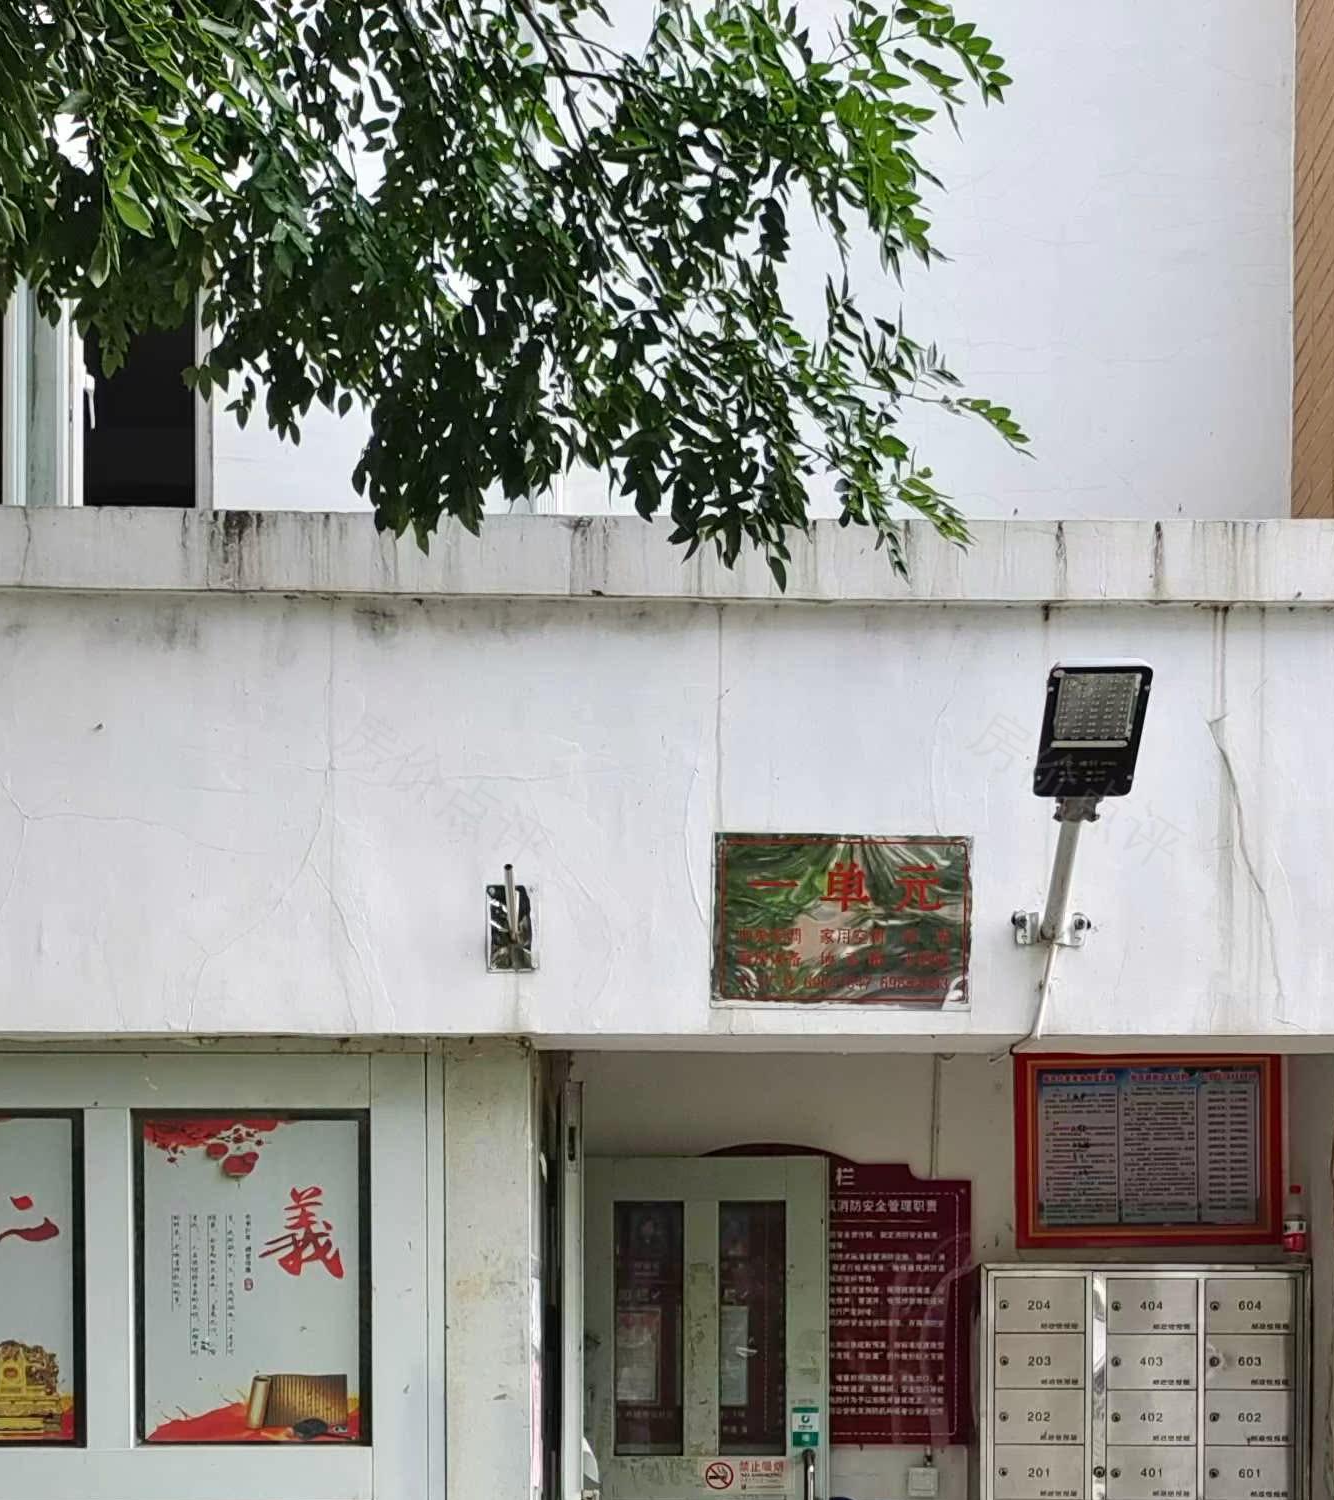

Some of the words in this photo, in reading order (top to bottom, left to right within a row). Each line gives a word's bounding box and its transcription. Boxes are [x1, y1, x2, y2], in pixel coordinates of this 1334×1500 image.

[746, 862, 944, 912] 一单元
[1027, 1300, 1051, 1311] 204
[1139, 1300, 1163, 1311] 404
[1238, 1300, 1262, 1311] 604
[1027, 1355, 1052, 1367] 203
[1139, 1356, 1163, 1367] 403
[1237, 1356, 1262, 1367] 603
[1027, 1411, 1051, 1422] 202
[1139, 1411, 1163, 1422] 402
[1237, 1412, 1262, 1423] 602
[1027, 1467, 1050, 1478] 201
[1140, 1467, 1162, 1478] 401
[1238, 1468, 1260, 1479] 601
